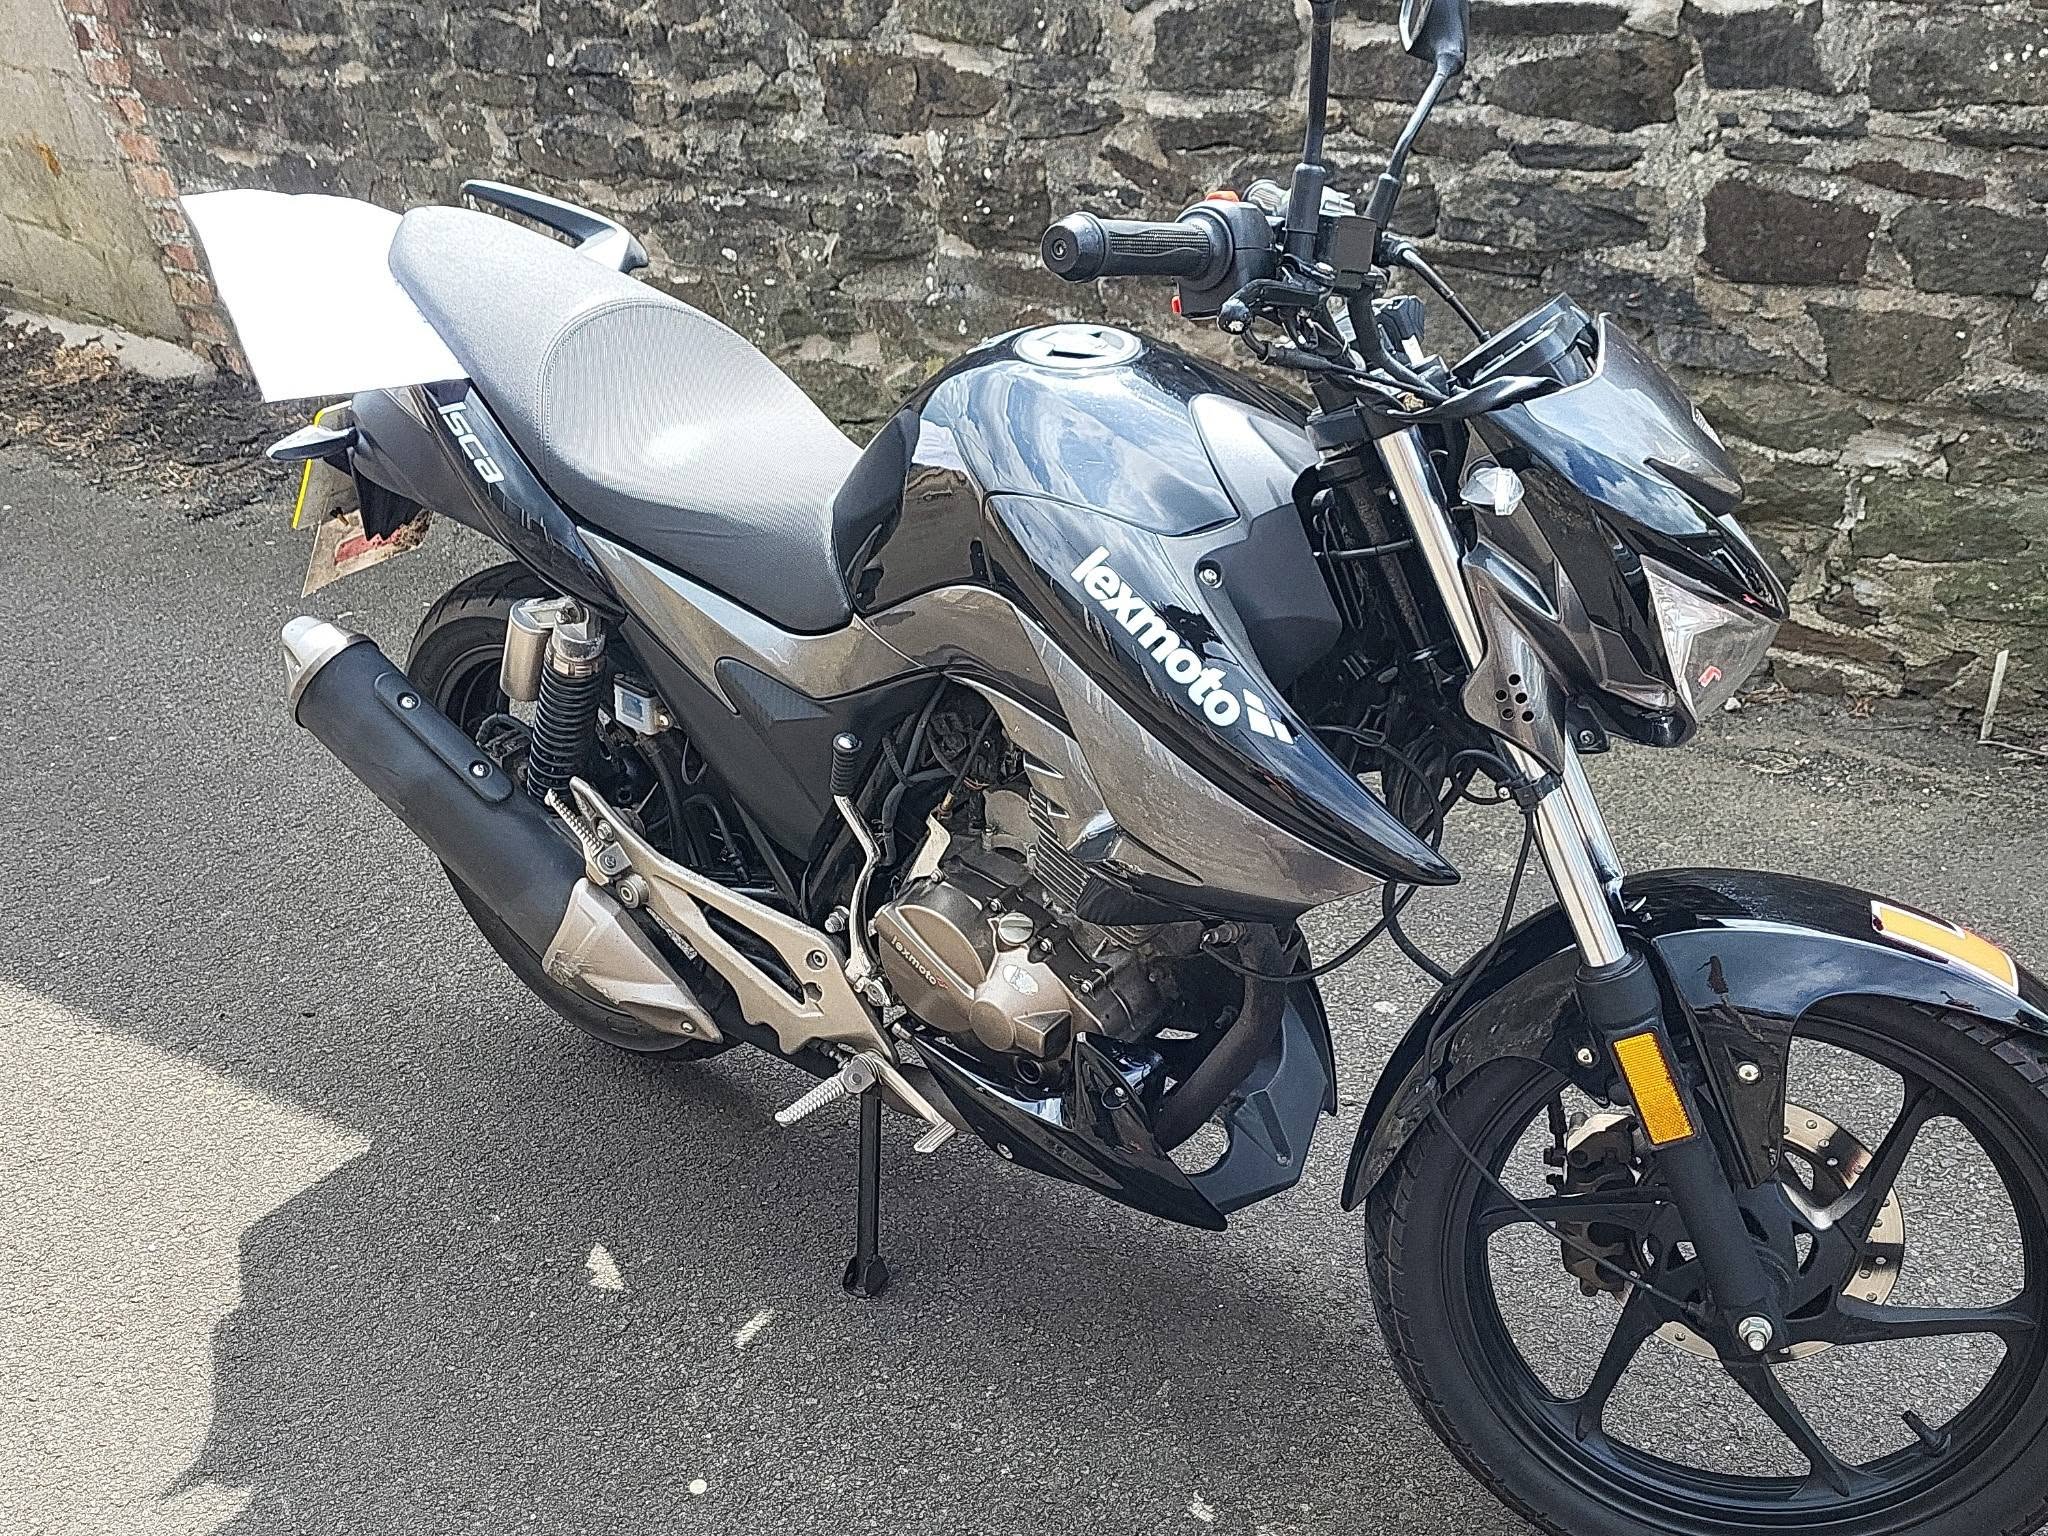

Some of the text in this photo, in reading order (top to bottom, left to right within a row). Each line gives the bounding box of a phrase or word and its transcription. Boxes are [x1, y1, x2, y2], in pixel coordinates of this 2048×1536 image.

[438, 401, 505, 483] Isca
[1070, 545, 1241, 727] lexmoto
[891, 935, 937, 986] lexmoto
